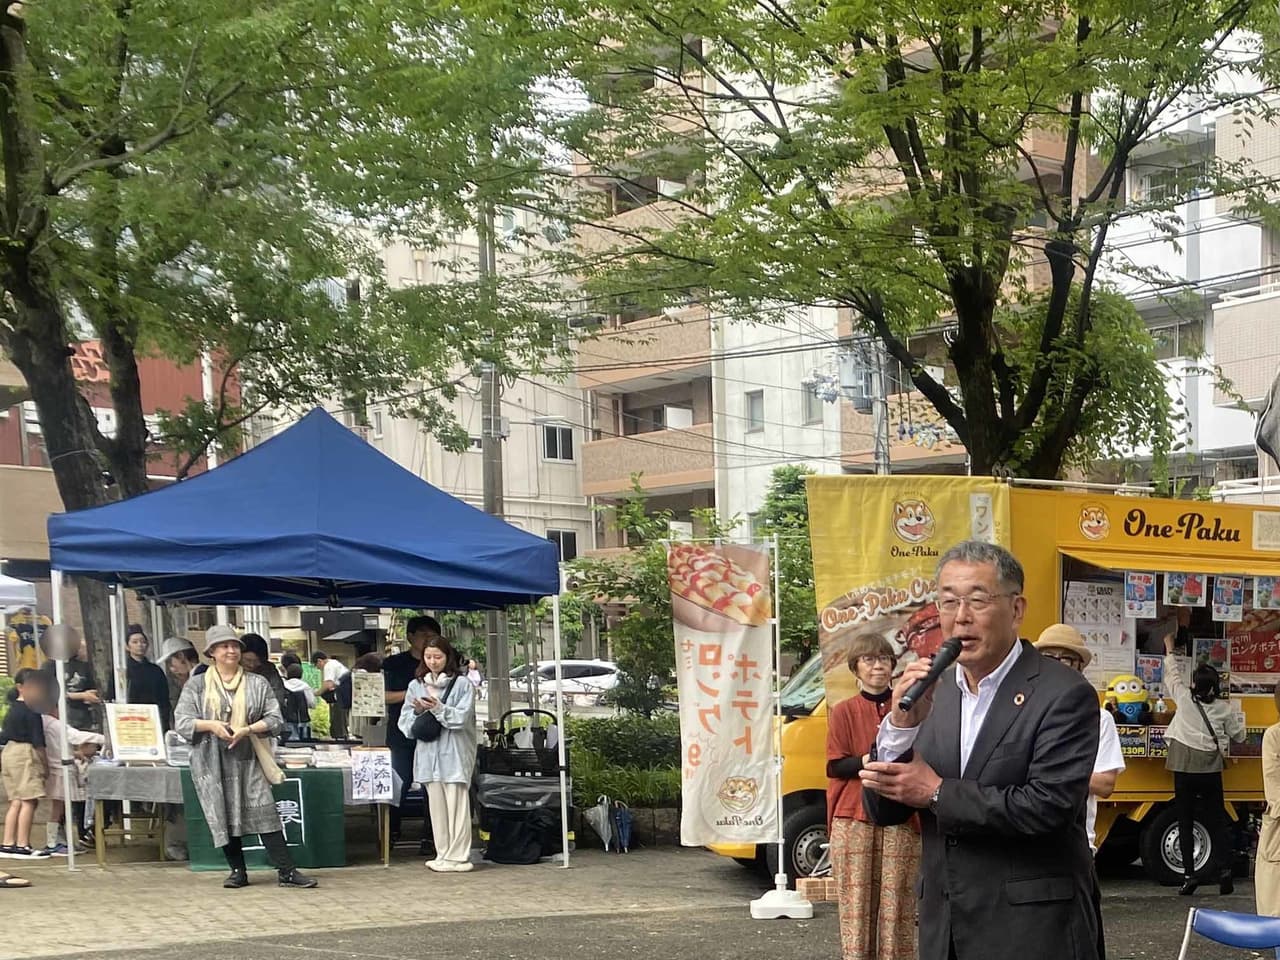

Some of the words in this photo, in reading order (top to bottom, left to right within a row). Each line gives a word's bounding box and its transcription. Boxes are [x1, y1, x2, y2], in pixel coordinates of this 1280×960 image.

[1124, 508, 1241, 542] One-Paku
[891, 545, 939, 558] One-Paku
[823, 587, 910, 630] One-Paku
